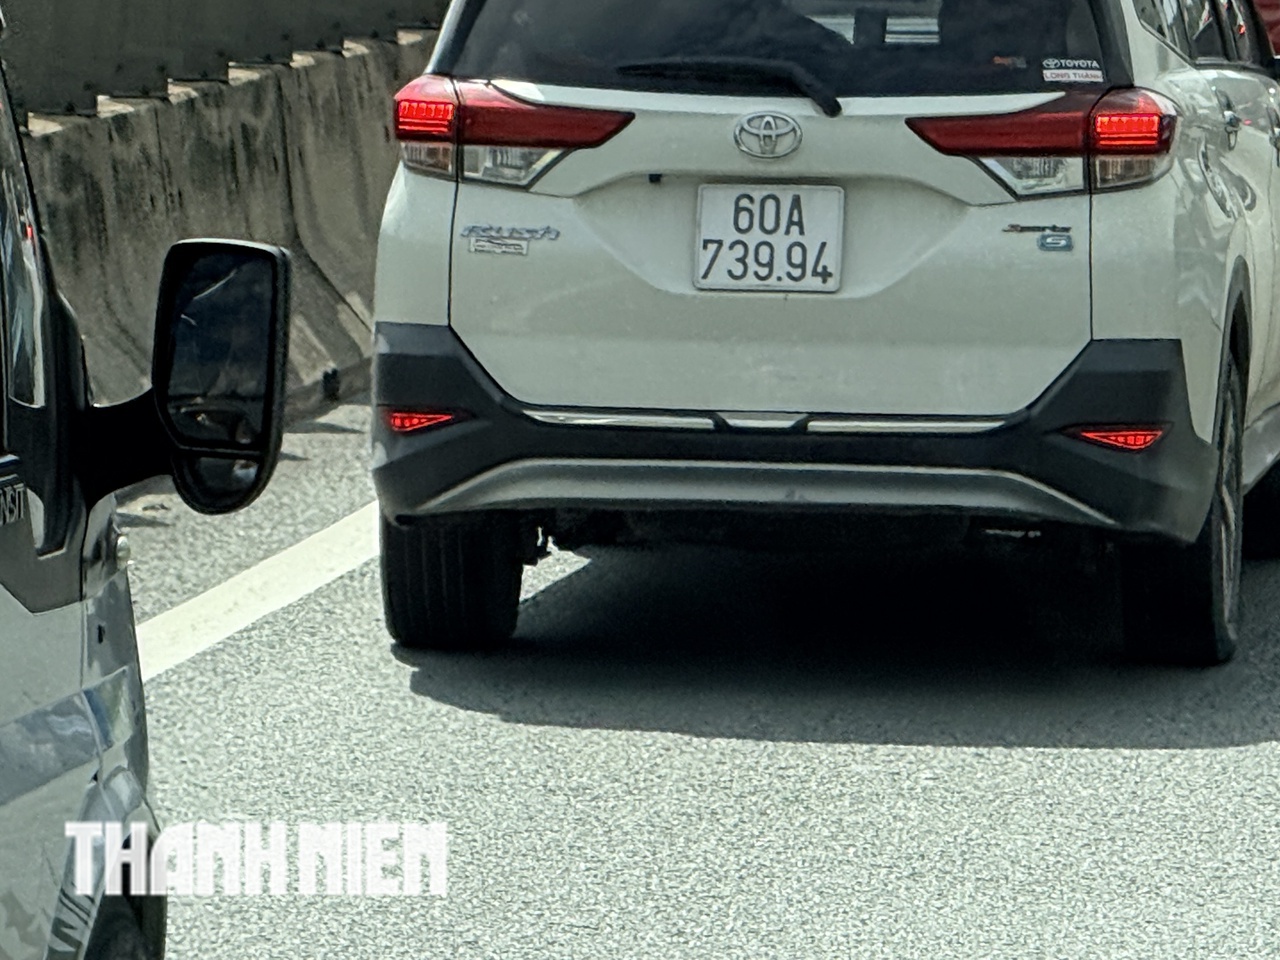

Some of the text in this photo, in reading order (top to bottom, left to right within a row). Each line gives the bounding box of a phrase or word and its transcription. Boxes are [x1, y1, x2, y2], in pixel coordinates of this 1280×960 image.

[1060, 59, 1100, 68] TOYOTA
[733, 193, 805, 236] 60A
[701, 239, 833, 284] 739.94
